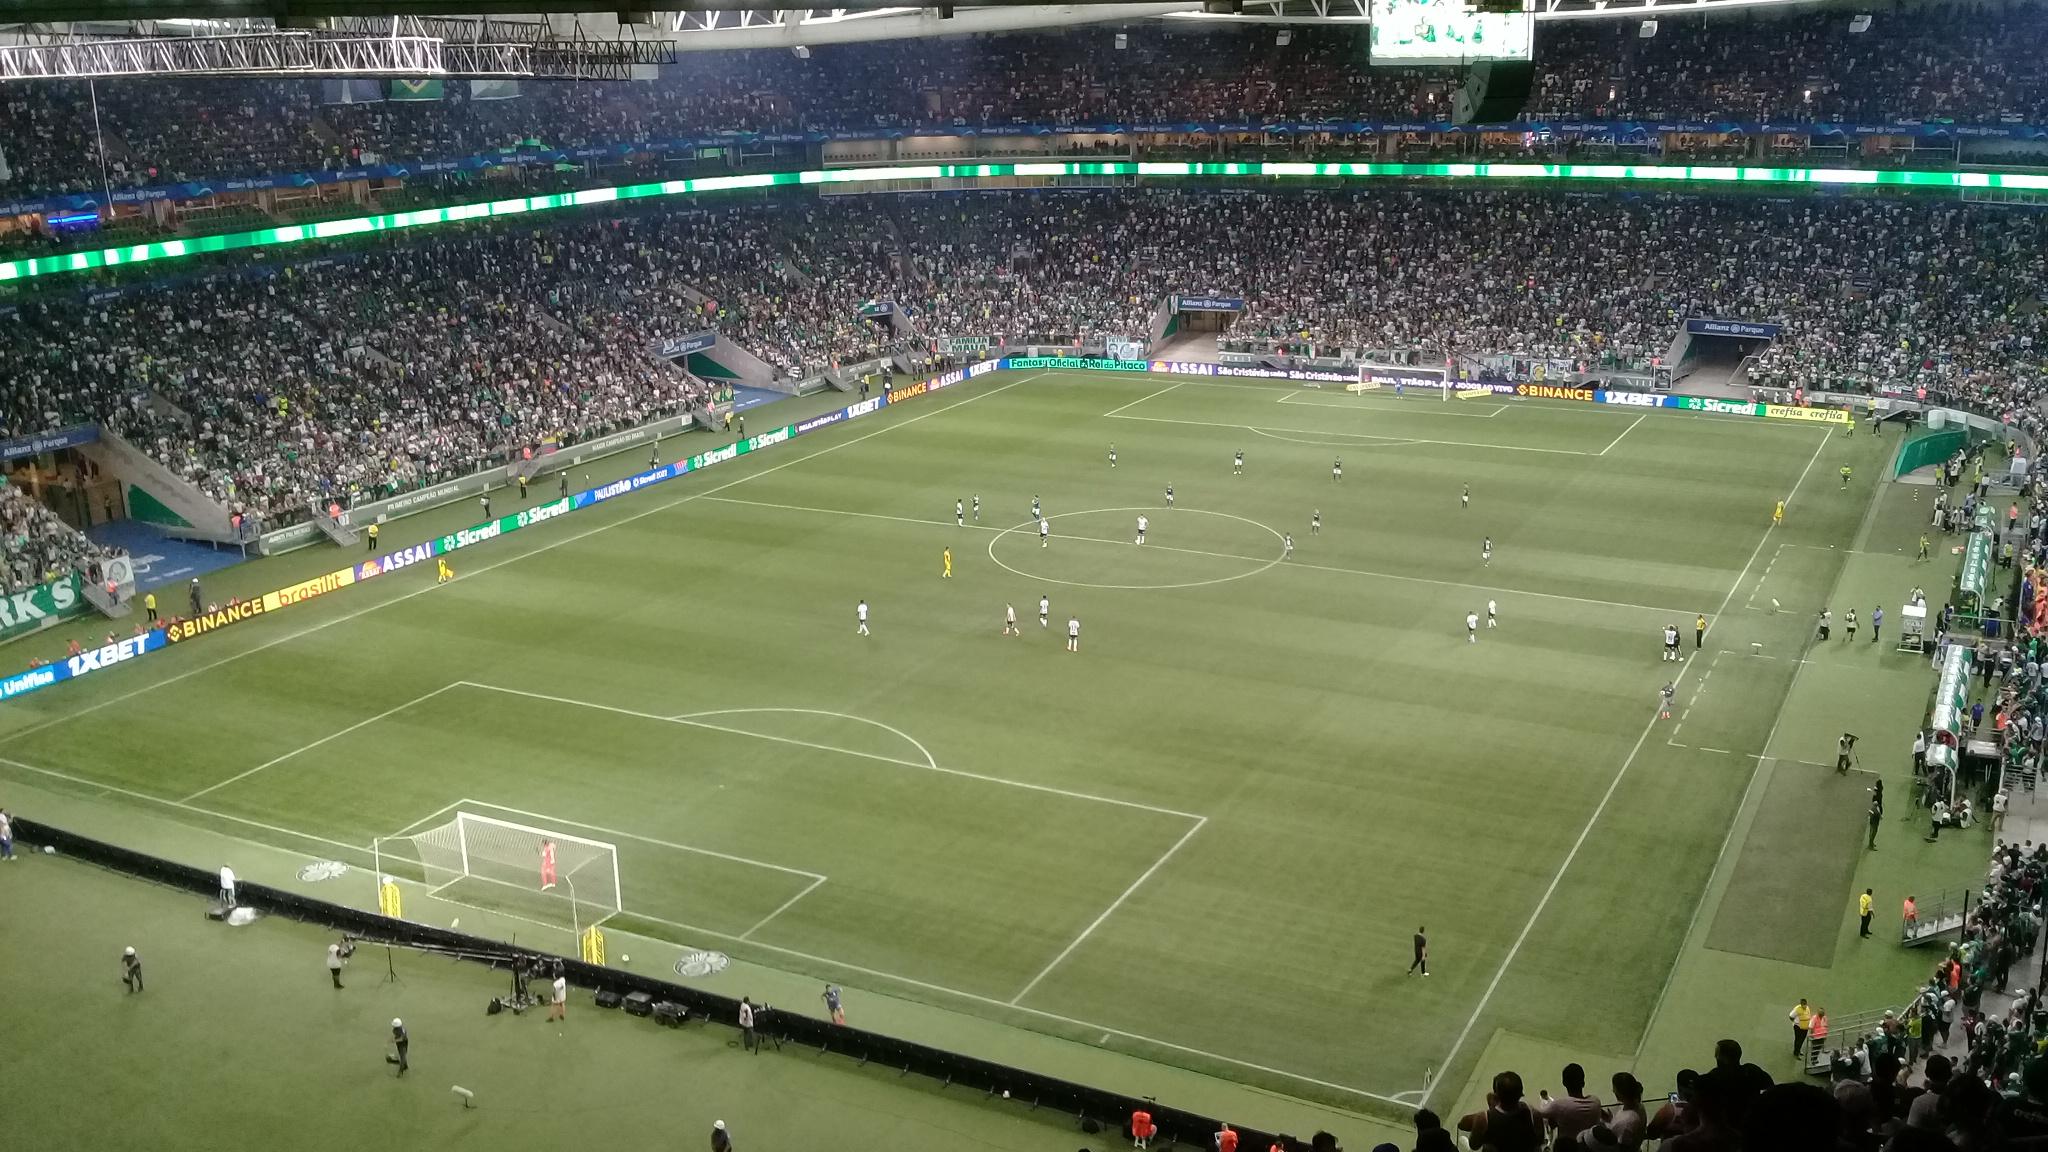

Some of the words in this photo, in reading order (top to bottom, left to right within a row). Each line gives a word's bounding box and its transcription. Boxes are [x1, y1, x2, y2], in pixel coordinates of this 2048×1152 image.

[1211, 301, 1231, 309] Parque
[1704, 323, 1730, 331] Allianz
[1740, 325, 1764, 334] Parque
[969, 358, 1000, 378] 1XBET
[1011, 358, 1048, 368] Fantasy
[1049, 358, 1079, 368] Oficial
[1089, 358, 1104, 369] Rei
[1114, 359, 1146, 370] Pitaco
[1217, 365, 1233, 376] São
[1289, 369, 1305, 380] São
[893, 382, 927, 403] BINANCE
[1493, 385, 1513, 393] VIVO
[1529, 385, 1593, 401] BINANCE
[847, 396, 880, 418] 1XBET
[1604, 390, 1668, 407] 1XBET
[1702, 398, 1757, 415] Sicredi
[1770, 407, 1802, 421] crefisa
[1810, 408, 1843, 422] crefisa
[3, 445, 33, 457] Allianz
[43, 436, 68, 449] Parque
[757, 426, 788, 449] Sicredi
[703, 443, 737, 467] Sicredi
[594, 479, 632, 501] PAULISTÃO
[528, 496, 570, 524] Sicredi
[456, 519, 501, 548] Sicredi
[278, 573, 341, 607] brasilit
[183, 598, 263, 639] BINANCE
[67, 633, 150, 678] 1XBET
